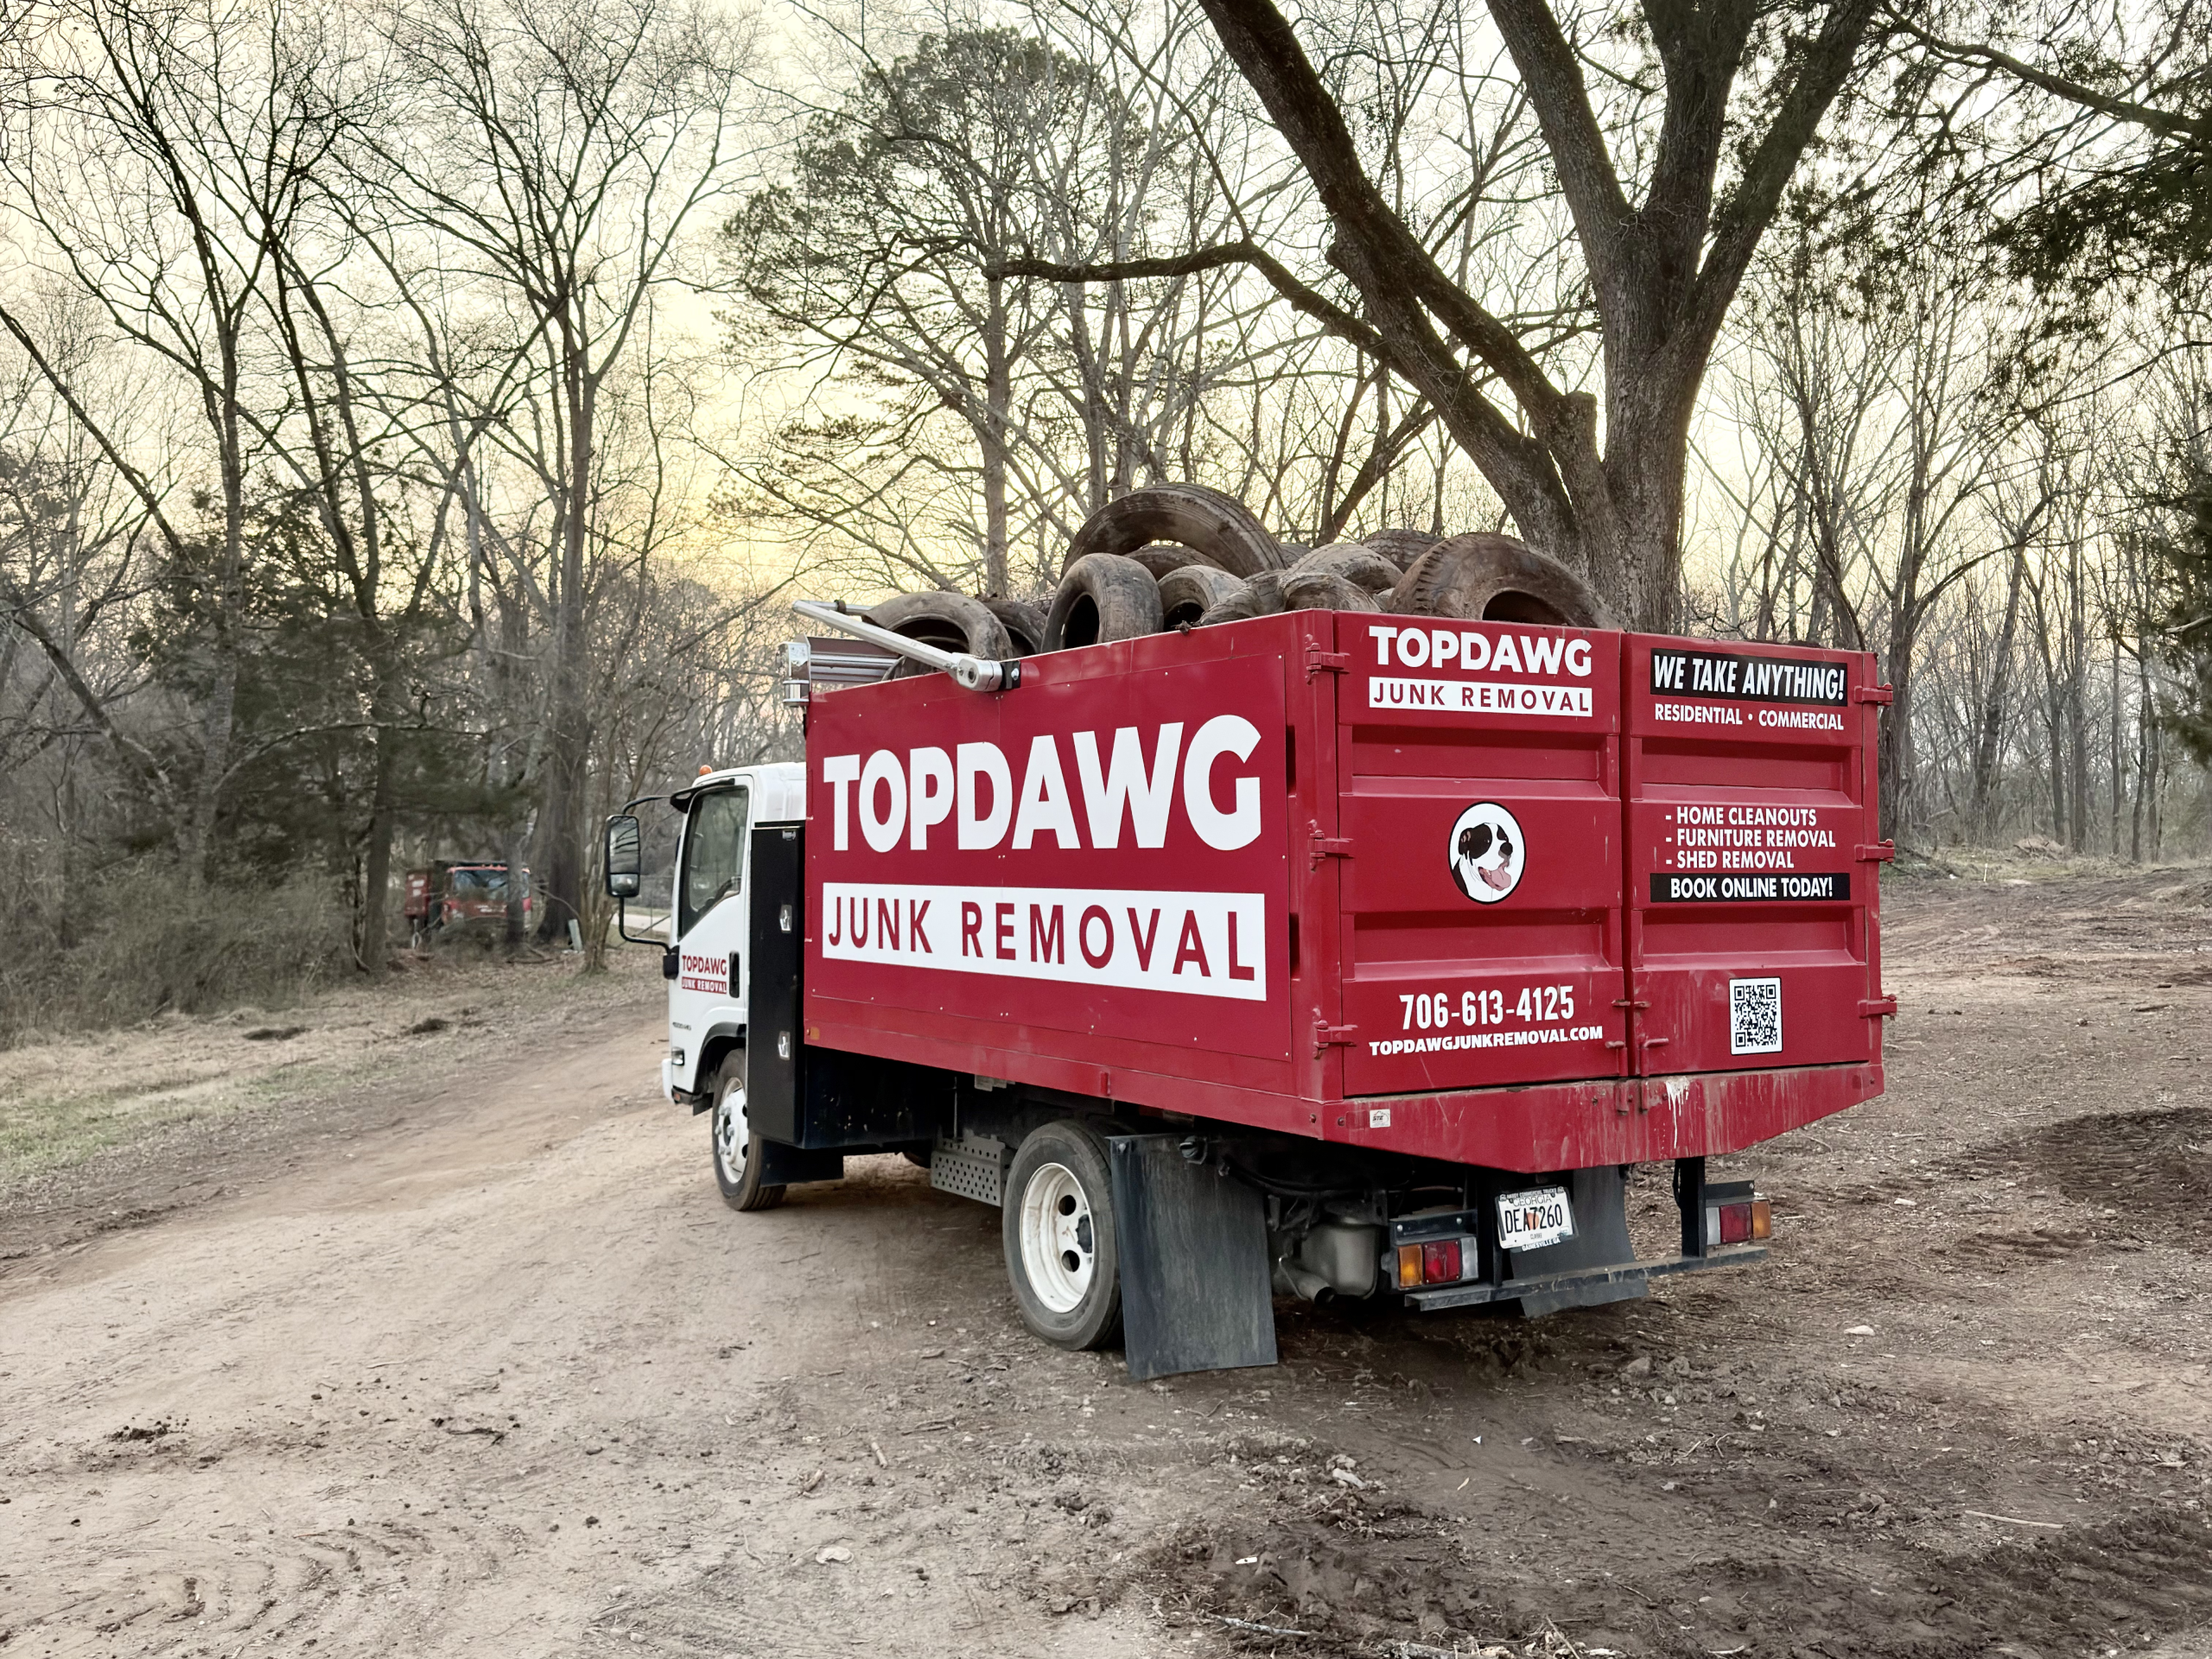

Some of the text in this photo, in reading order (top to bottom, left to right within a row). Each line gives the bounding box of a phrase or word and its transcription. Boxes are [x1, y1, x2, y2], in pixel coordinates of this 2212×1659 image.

[1369, 626, 1592, 677] TOPDAWG
[1654, 655, 1844, 700] WE TAKE ANYTHING!
[1374, 683, 1589, 712] JUNK REMOVAL
[1655, 703, 1743, 725] RESIDENTIAL
[1758, 710, 1844, 730] COMMERCIAL
[823, 715, 1262, 852] TOPDAWG
[1677, 806, 1724, 825] HOME
[1728, 808, 1817, 826] CLEANOUTS
[1677, 829, 1762, 847] FURNITURE
[1766, 830, 1836, 848] REMOVAL
[1677, 850, 1717, 868] SHED
[1722, 851, 1795, 868] REMOVAL
[1670, 876, 1833, 899] BOOK ONLINE TODAY!
[829, 896, 1255, 982] JUNK REMOVAL
[682, 955, 727, 976] TOPDAWG
[697, 980, 727, 993] REMOVAL
[1399, 986, 1574, 1030] 706-613-4125
[1370, 1026, 1603, 1056] TOPDAWGJUNKREMOVAL.COM
[1513, 1195, 1552, 1206] GEORGIA
[1504, 1204, 1562, 1233] DEA7260
